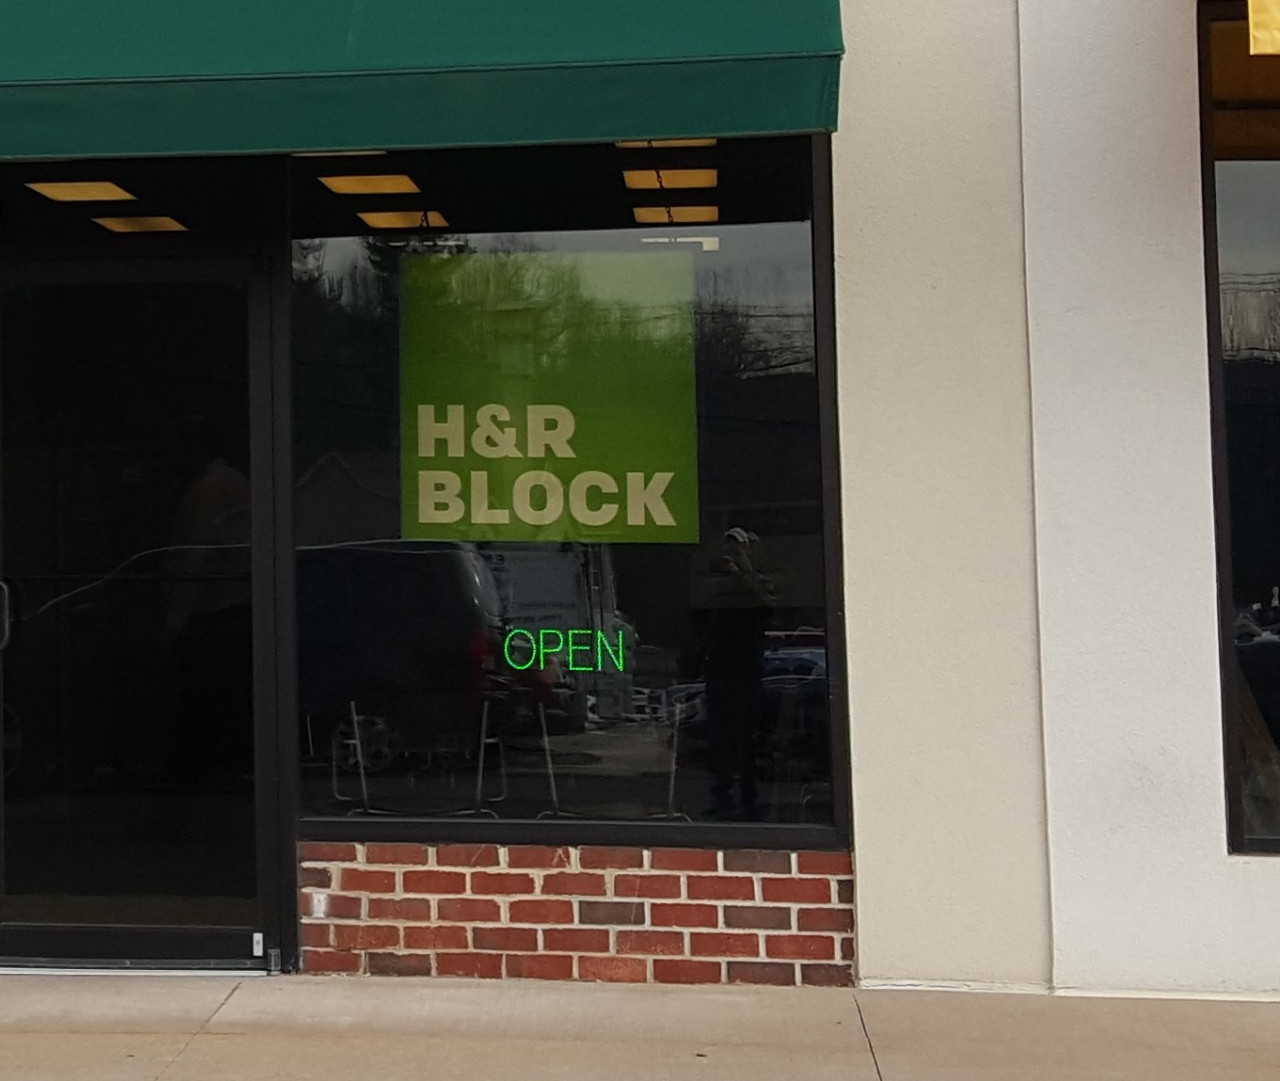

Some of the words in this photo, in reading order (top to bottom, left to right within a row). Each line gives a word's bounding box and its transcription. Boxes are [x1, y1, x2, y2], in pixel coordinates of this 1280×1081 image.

[417, 403, 577, 459] H&R
[417, 470, 677, 527] BLOCK
[503, 628, 625, 672] OPEN
